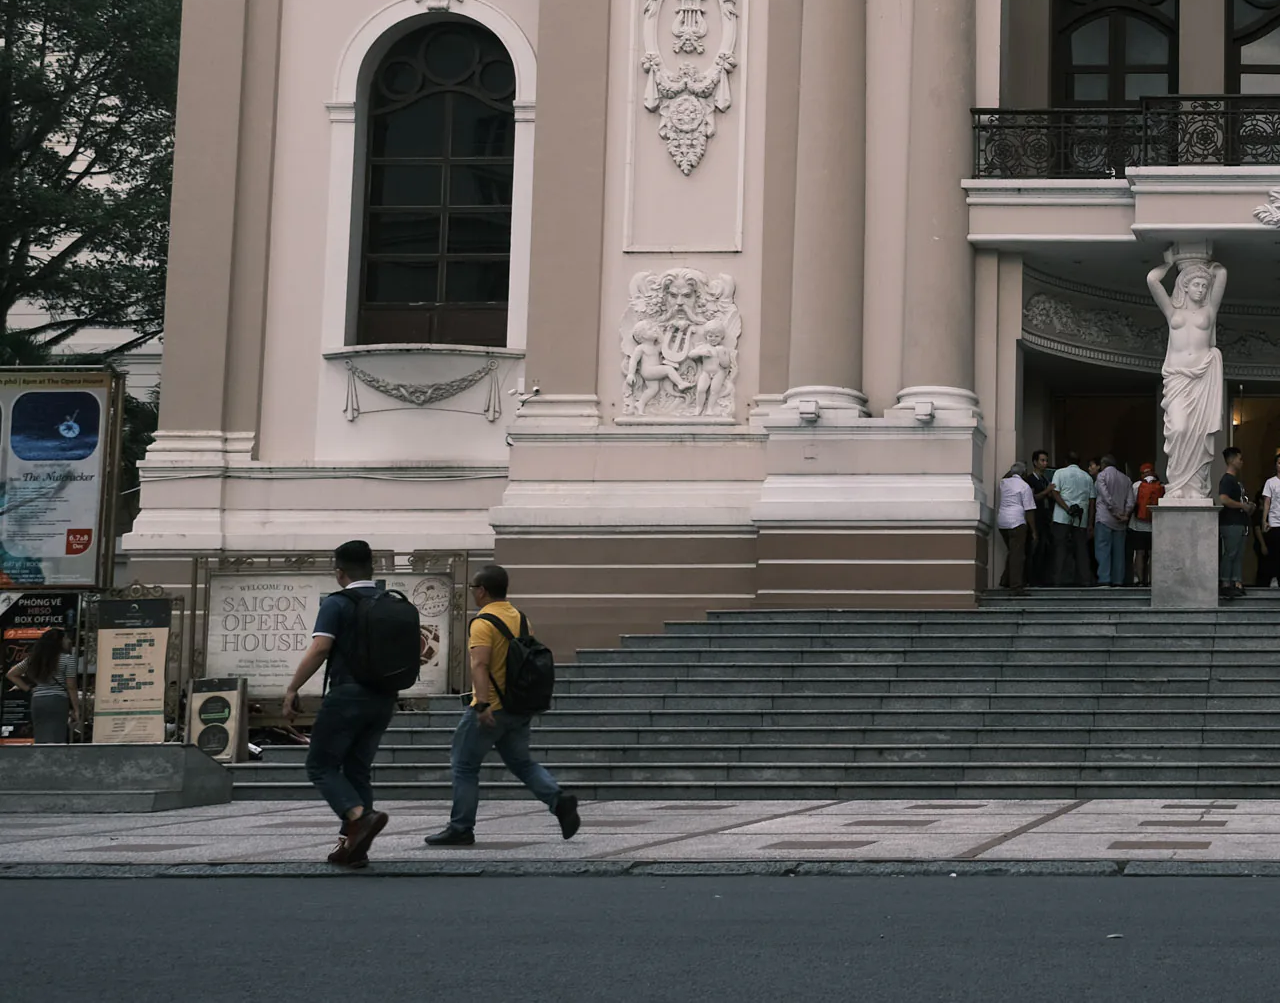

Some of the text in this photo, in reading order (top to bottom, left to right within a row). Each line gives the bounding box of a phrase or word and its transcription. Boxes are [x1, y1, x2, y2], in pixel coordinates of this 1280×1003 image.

[23, 473, 40, 482] The
[223, 597, 307, 612] SAIGON
[14, 615, 63, 624] BOX OFFICE
[222, 614, 307, 631] OPERA
[221, 634, 307, 652] HOUSE
